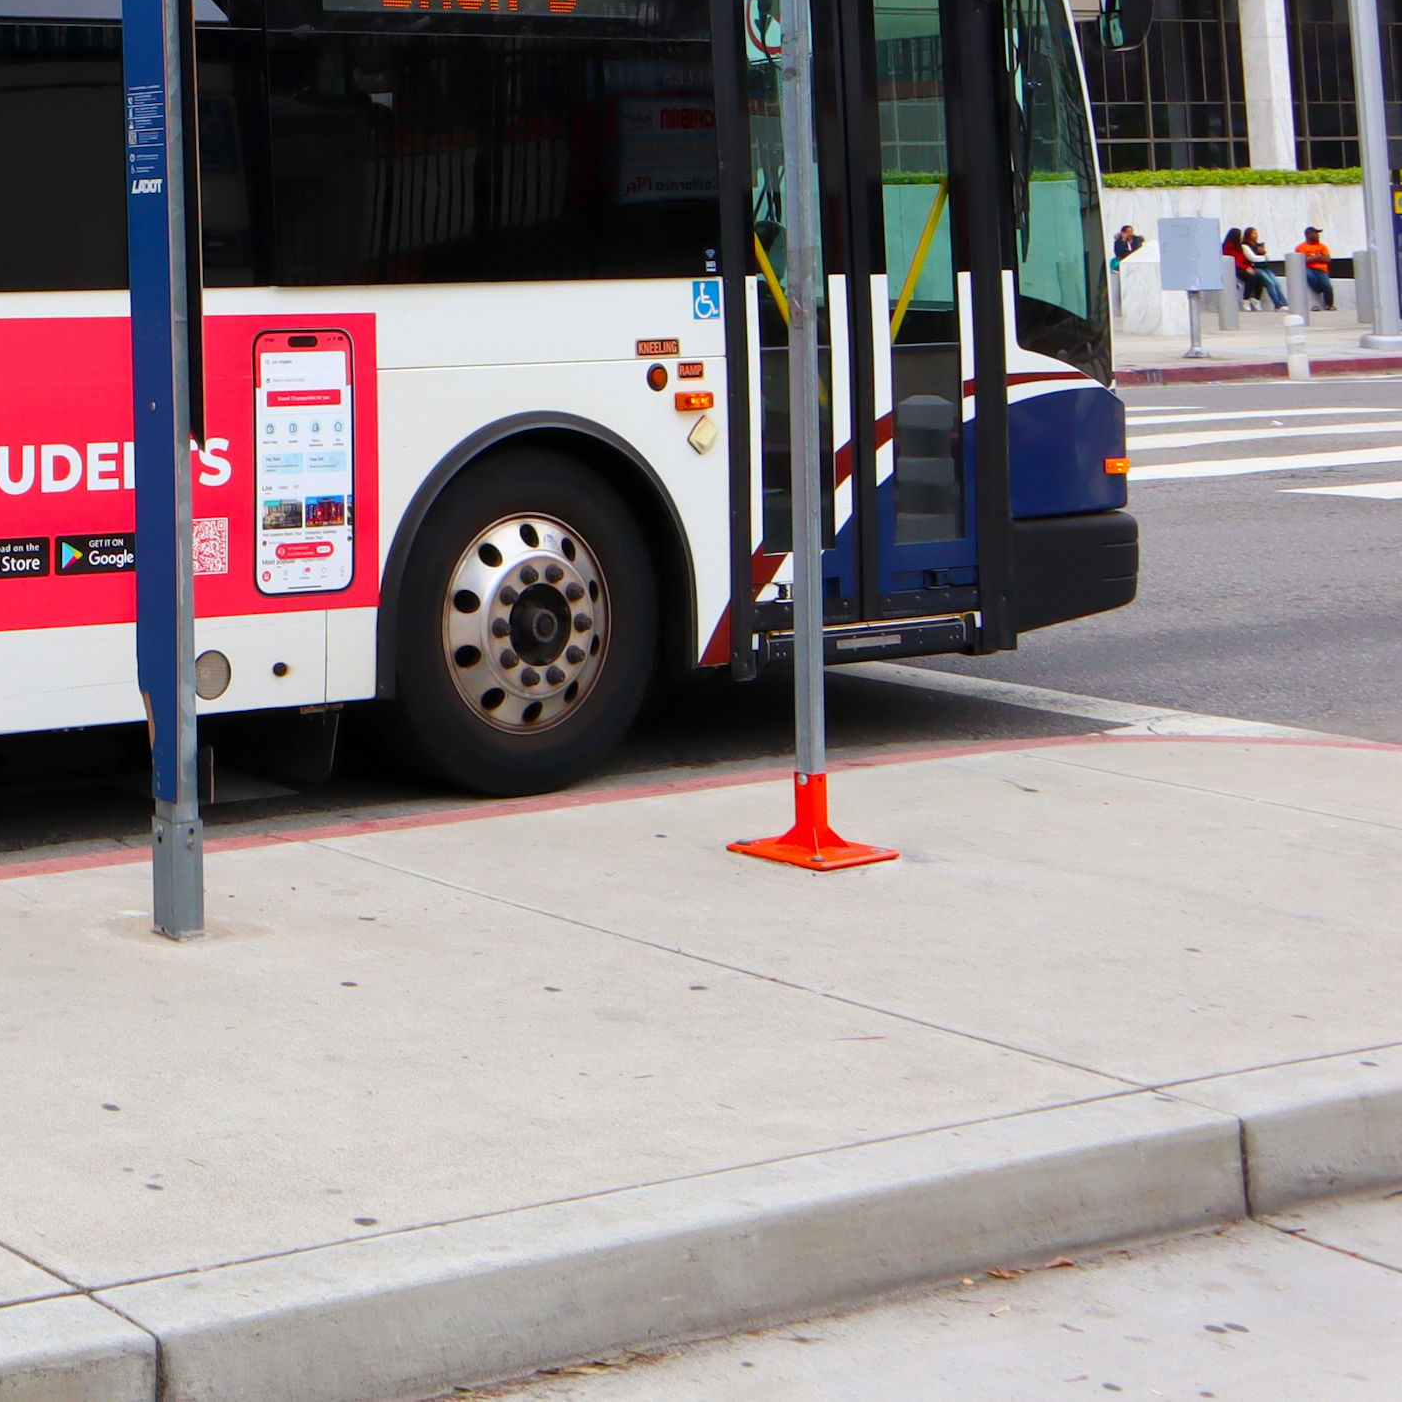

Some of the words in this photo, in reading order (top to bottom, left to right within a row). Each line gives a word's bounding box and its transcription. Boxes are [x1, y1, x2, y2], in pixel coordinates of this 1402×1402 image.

[638, 341, 678, 355] KNEELING
[679, 363, 702, 377] RAMP
[12, 545, 24, 553] on
[26, 543, 40, 552] the
[88, 539, 104, 548] GET
[105, 539, 112, 547] IT
[112, 538, 124, 547] ON
[1, 556, 41, 571] Store
[88, 549, 134, 568] Google
